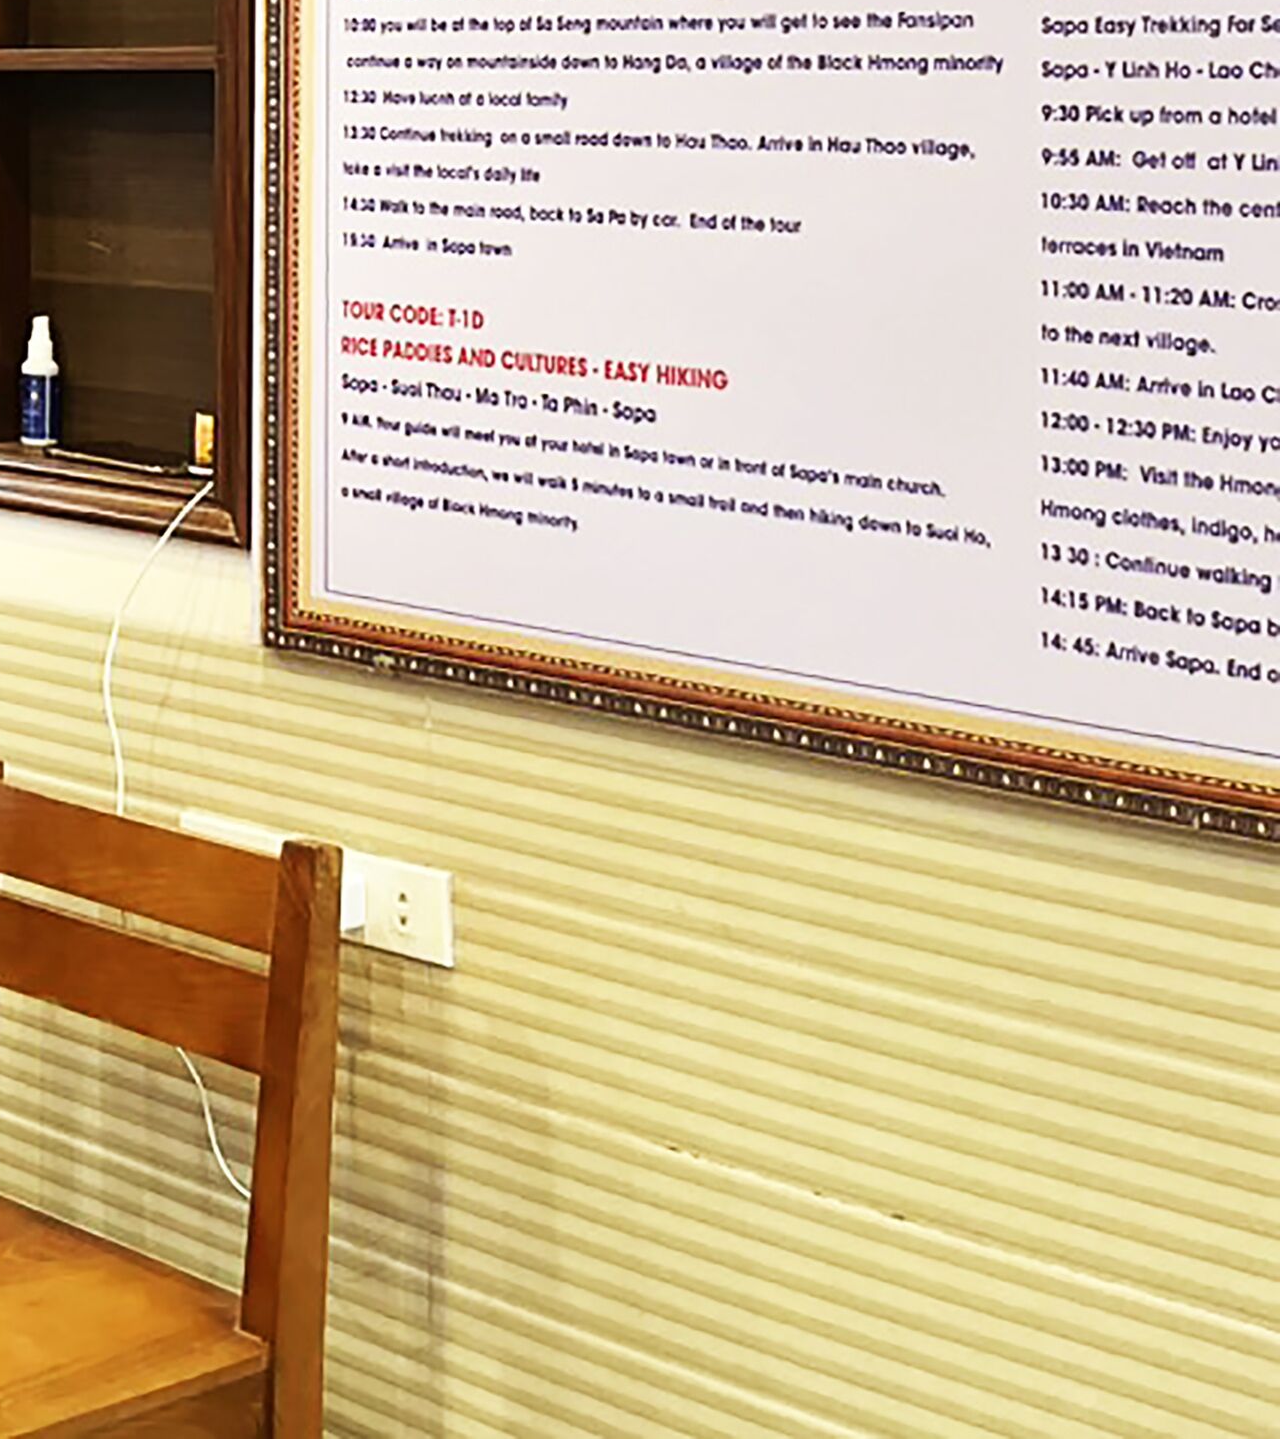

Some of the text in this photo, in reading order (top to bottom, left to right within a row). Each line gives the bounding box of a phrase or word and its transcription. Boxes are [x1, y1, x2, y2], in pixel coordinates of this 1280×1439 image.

[1041, 16, 1089, 37] Sapa
[1095, 16, 1136, 38] Easy
[1141, 15, 1221, 39] Trekking
[1227, 14, 1256, 34] For
[1041, 60, 1089, 81] Sapa
[1105, 61, 1117, 79] Y
[1122, 61, 1160, 79] Linh
[1165, 61, 1192, 79] Ho
[1208, 61, 1244, 80] Lao
[1041, 104, 1277, 127] 9:30 Pick up from a hotel
[1041, 236, 1224, 262] terraces in Vietnam
[342, 300, 484, 330] TOUR CODE: T-1D
[1041, 324, 1216, 357] to the next village.
[341, 335, 378, 357] RICE
[382, 339, 453, 364] PADDIES
[457, 346, 496, 368] AND
[500, 350, 588, 377] CULTURES
[604, 359, 650, 383] EASY
[656, 364, 728, 390] HIKING
[1095, 595, 1128, 616] PM:
[1134, 600, 1181, 624] Back
[1186, 607, 1206, 627] to
[1211, 610, 1262, 636] Sapa
